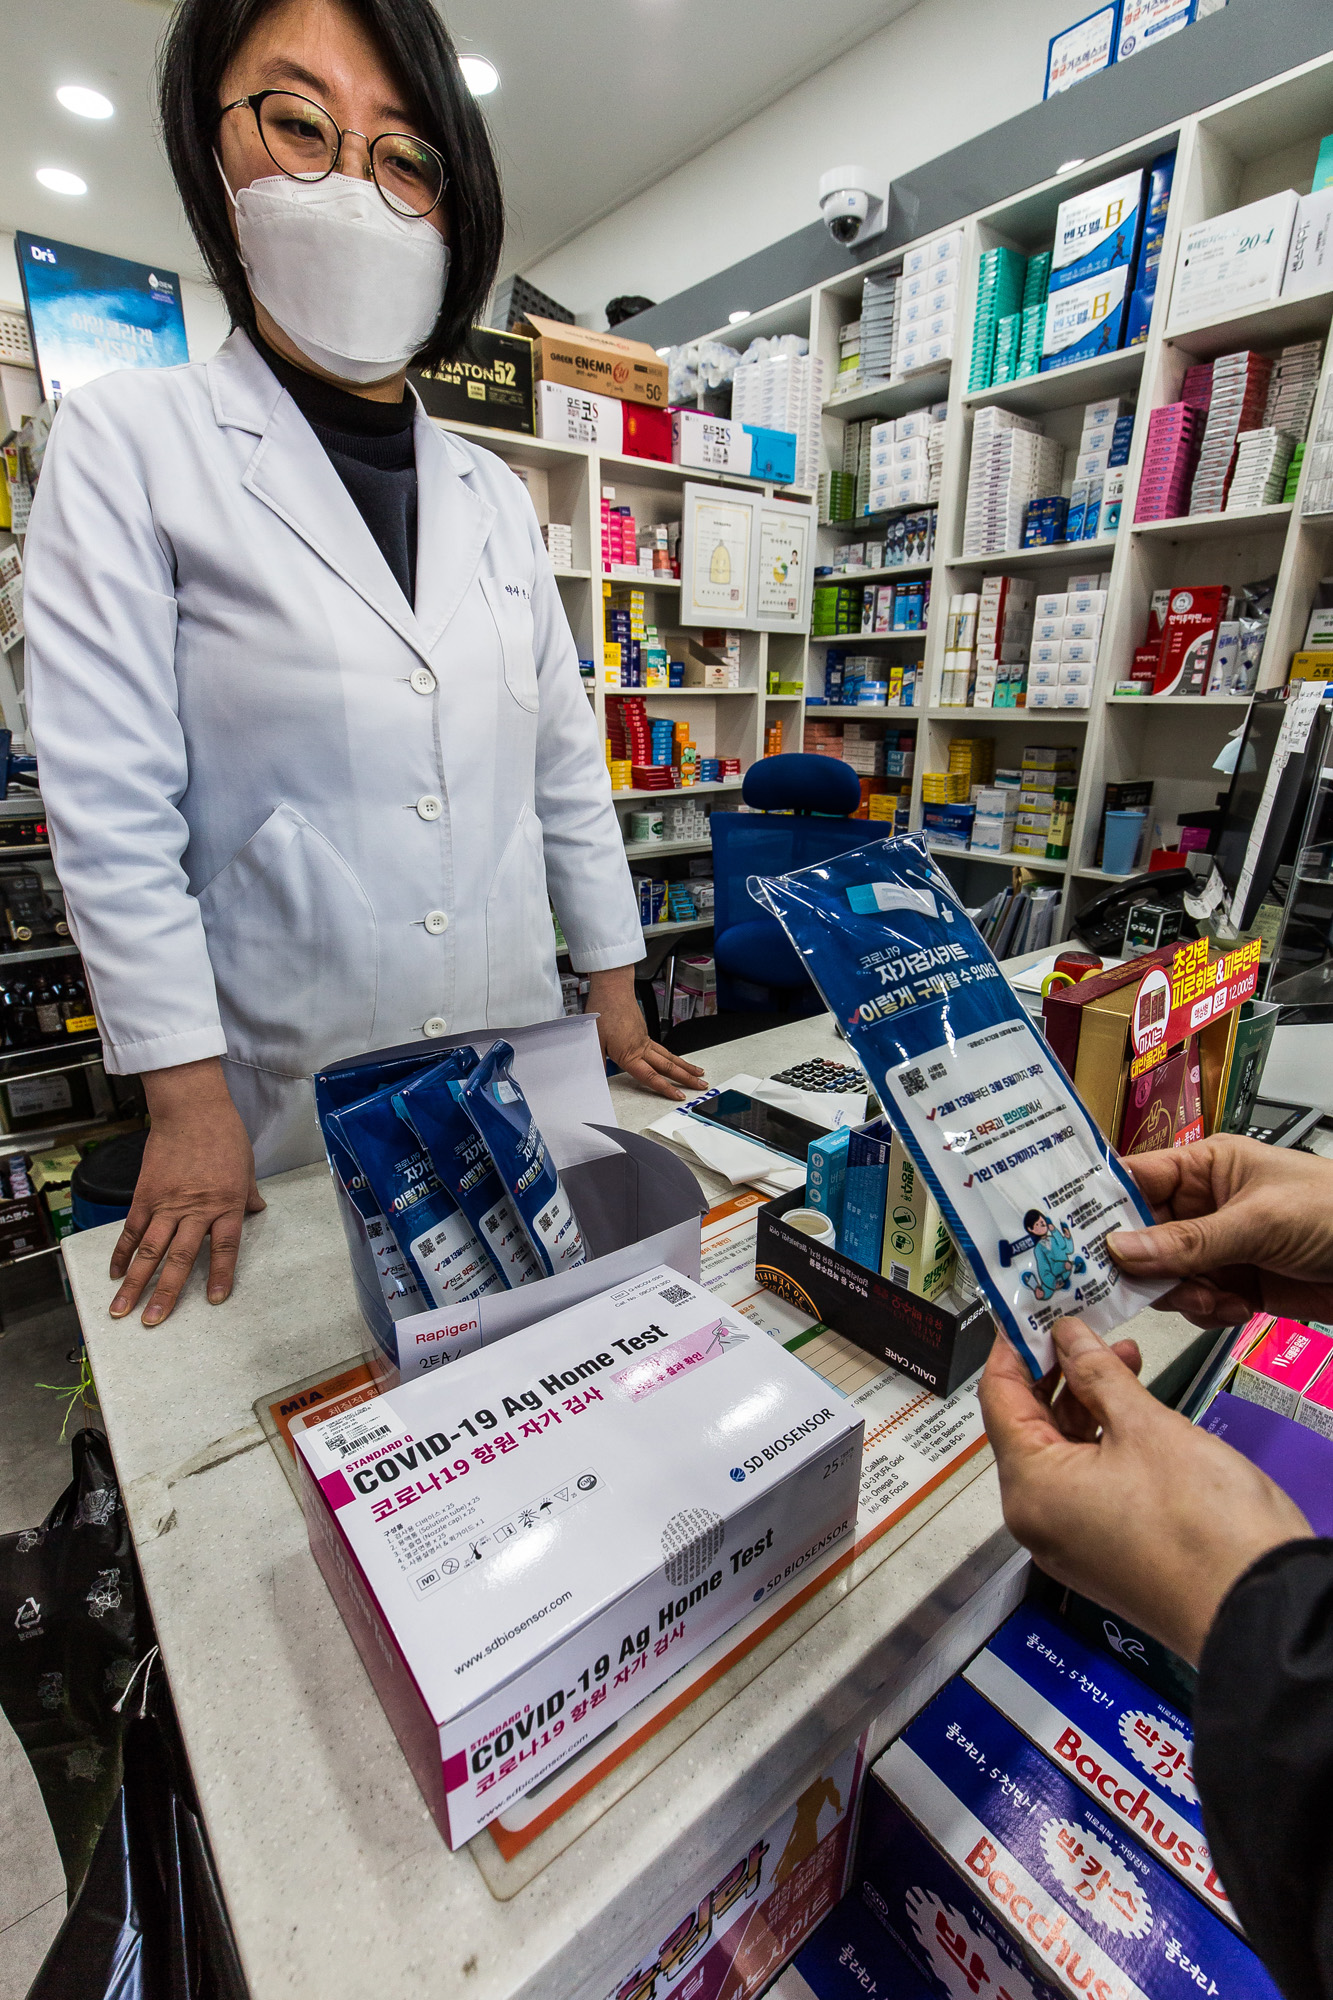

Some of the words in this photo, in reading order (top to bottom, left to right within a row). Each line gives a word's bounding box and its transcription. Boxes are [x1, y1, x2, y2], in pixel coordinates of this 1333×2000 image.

[550, 352, 573, 365] GREEN
[575, 356, 612, 375] ENEMA
[859, 945, 900, 968] 코로나19
[874, 942, 969, 985] 자가검사키트
[1173, 936, 1209, 981] 초강력
[1170, 936, 1262, 1010] 피로회복&피부탄력
[1228, 974, 1255, 1001] 12,000원
[859, 986, 917, 1022] 이렇게
[913, 973, 961, 999] 구매할
[960, 970, 973, 984] 수
[970, 962, 999, 981] 있어요
[1138, 1026, 1163, 1054] 마시는
[937, 1101, 957, 1117] 2월
[954, 1086, 990, 1109] 13일부터
[988, 1079, 1004, 1094] 3월
[1002, 1069, 1028, 1089] 5일까지
[1028, 1063, 1043, 1078] 3주간
[976, 1116, 1004, 1136] 약국과
[1002, 1098, 1043, 1125] 편의점에서
[459, 1163, 487, 1191] 이렇게
[517, 1158, 542, 1190] 이렇게
[973, 1168, 994, 1184] 1인
[991, 1158, 1009, 1175] 1회
[394, 1181, 430, 1211] 이렇게
[415, 1319, 478, 1345] Rapigen
[884, 1347, 910, 1368] CARE
[908, 1363, 936, 1385] DAILY
[280, 1390, 325, 1416] MIA
[352, 1408, 498, 1495] COVID-19
[501, 1390, 544, 1418] Ag
[538, 1351, 615, 1396] Home
[610, 1323, 669, 1356] Test
[913, 1422, 926, 1436] Joint
[924, 1408, 946, 1426] Balance
[943, 1398, 957, 1410] Gold
[743, 1456, 764, 1474] SD
[761, 1407, 835, 1461] BIOSENSOR
[921, 1432, 932, 1442] NB
[929, 1420, 947, 1434] GOLD
[930, 1436, 944, 1448] Fem
[941, 1420, 964, 1438] Balance
[960, 1411, 975, 1422] Plus
[345, 1439, 404, 1473] STANDARD
[403, 1434, 414, 1445] Q
[370, 1459, 471, 1523] 코로나19
[470, 1432, 520, 1465] 항원
[517, 1408, 563, 1439] 자가
[561, 1385, 605, 1415] 검사
[864, 1454, 889, 1473] CalMag
[939, 1444, 953, 1455] Max
[823, 1457, 840, 1480] 25
[874, 1465, 892, 1481] PUFA
[889, 1454, 905, 1468] Gold
[870, 1479, 892, 1498] Omega
[891, 1473, 899, 1481] S
[879, 1493, 892, 1505] BR
[889, 1480, 909, 1498] Focus
[418, 1514, 449, 1536] (Solution
[448, 1504, 468, 1519] tube)
[421, 1522, 448, 1542] (Nozzle
[447, 1513, 464, 1528] cap)
[766, 1573, 782, 1593] SD
[784, 1520, 849, 1579] BIOSENSOR
[421, 1573, 436, 1587] IVD
[454, 1590, 573, 1675] www.sdbiosensor.com
[471, 1654, 610, 1775] COVID-19
[618, 1625, 651, 1665] Ag
[658, 1568, 723, 1633] Home
[729, 1527, 774, 1575] Test
[1026, 1633, 1066, 1674] 풀려라,
[1069, 1670, 1115, 1710] 5천만!
[475, 1720, 566, 1798] 코로나19
[570, 1682, 608, 1724] 항원
[613, 1652, 648, 1689] 자가
[653, 1621, 686, 1658] 검사
[1157, 1703, 1185, 1728] 피로회복
[470, 1711, 521, 1753] STANDARD
[523, 1704, 531, 1715] Q
[476, 1732, 589, 1825] www.sdbiosensor.com
[946, 1722, 986, 1773] 풀려라,
[989, 1767, 1041, 1815] 5천만!
[1151, 1760, 1174, 1779] D
[1084, 1810, 1114, 1842] 피로회복
[1056, 1828, 1141, 1923] 박카스
[1074, 1879, 1096, 1901] D
